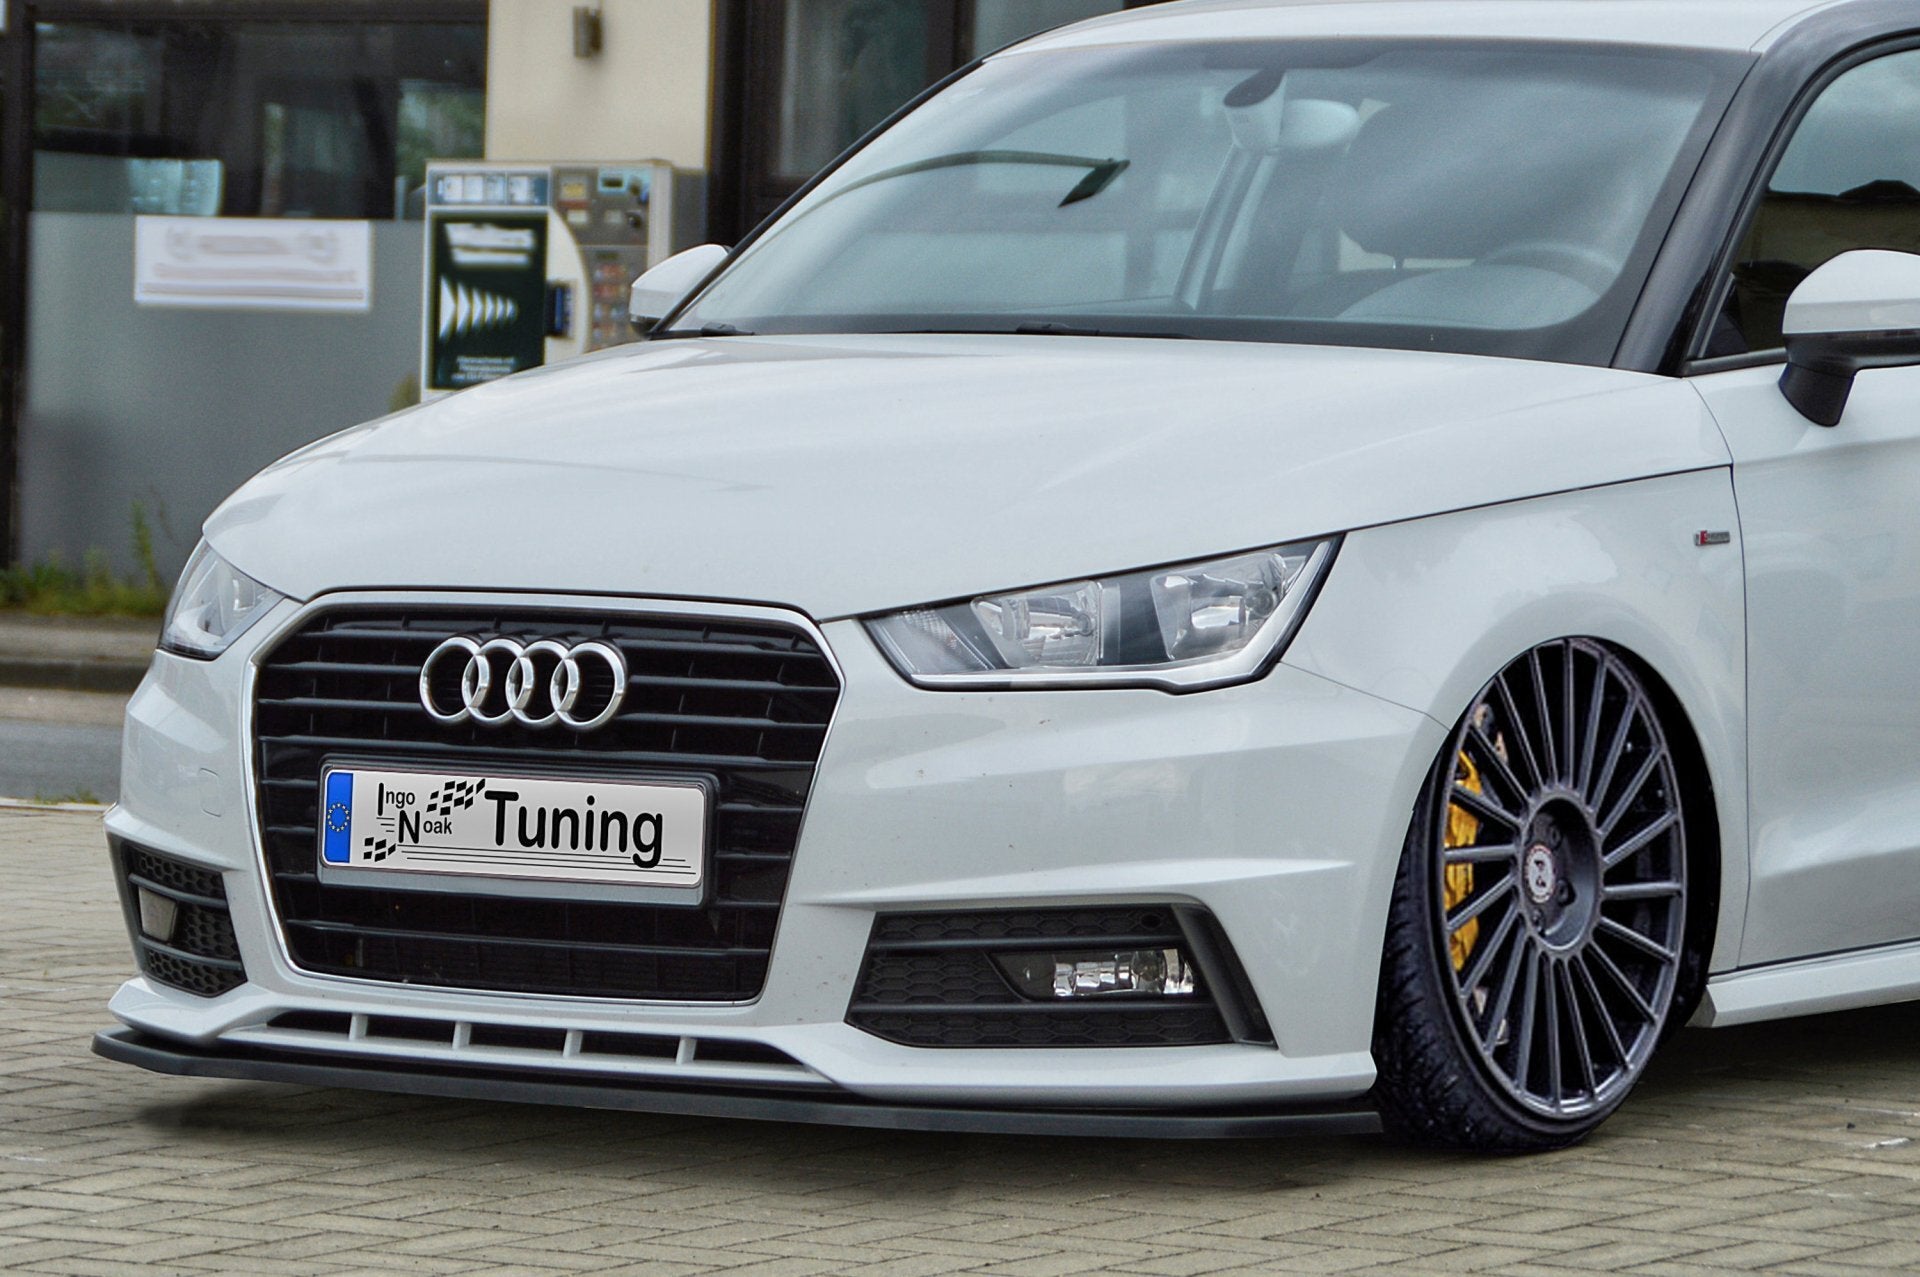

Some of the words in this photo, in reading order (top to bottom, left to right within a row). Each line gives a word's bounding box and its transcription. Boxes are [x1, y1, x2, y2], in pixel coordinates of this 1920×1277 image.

[377, 782, 416, 817] Ingo
[398, 809, 453, 845] Noak
[484, 790, 663, 869] Tuning
